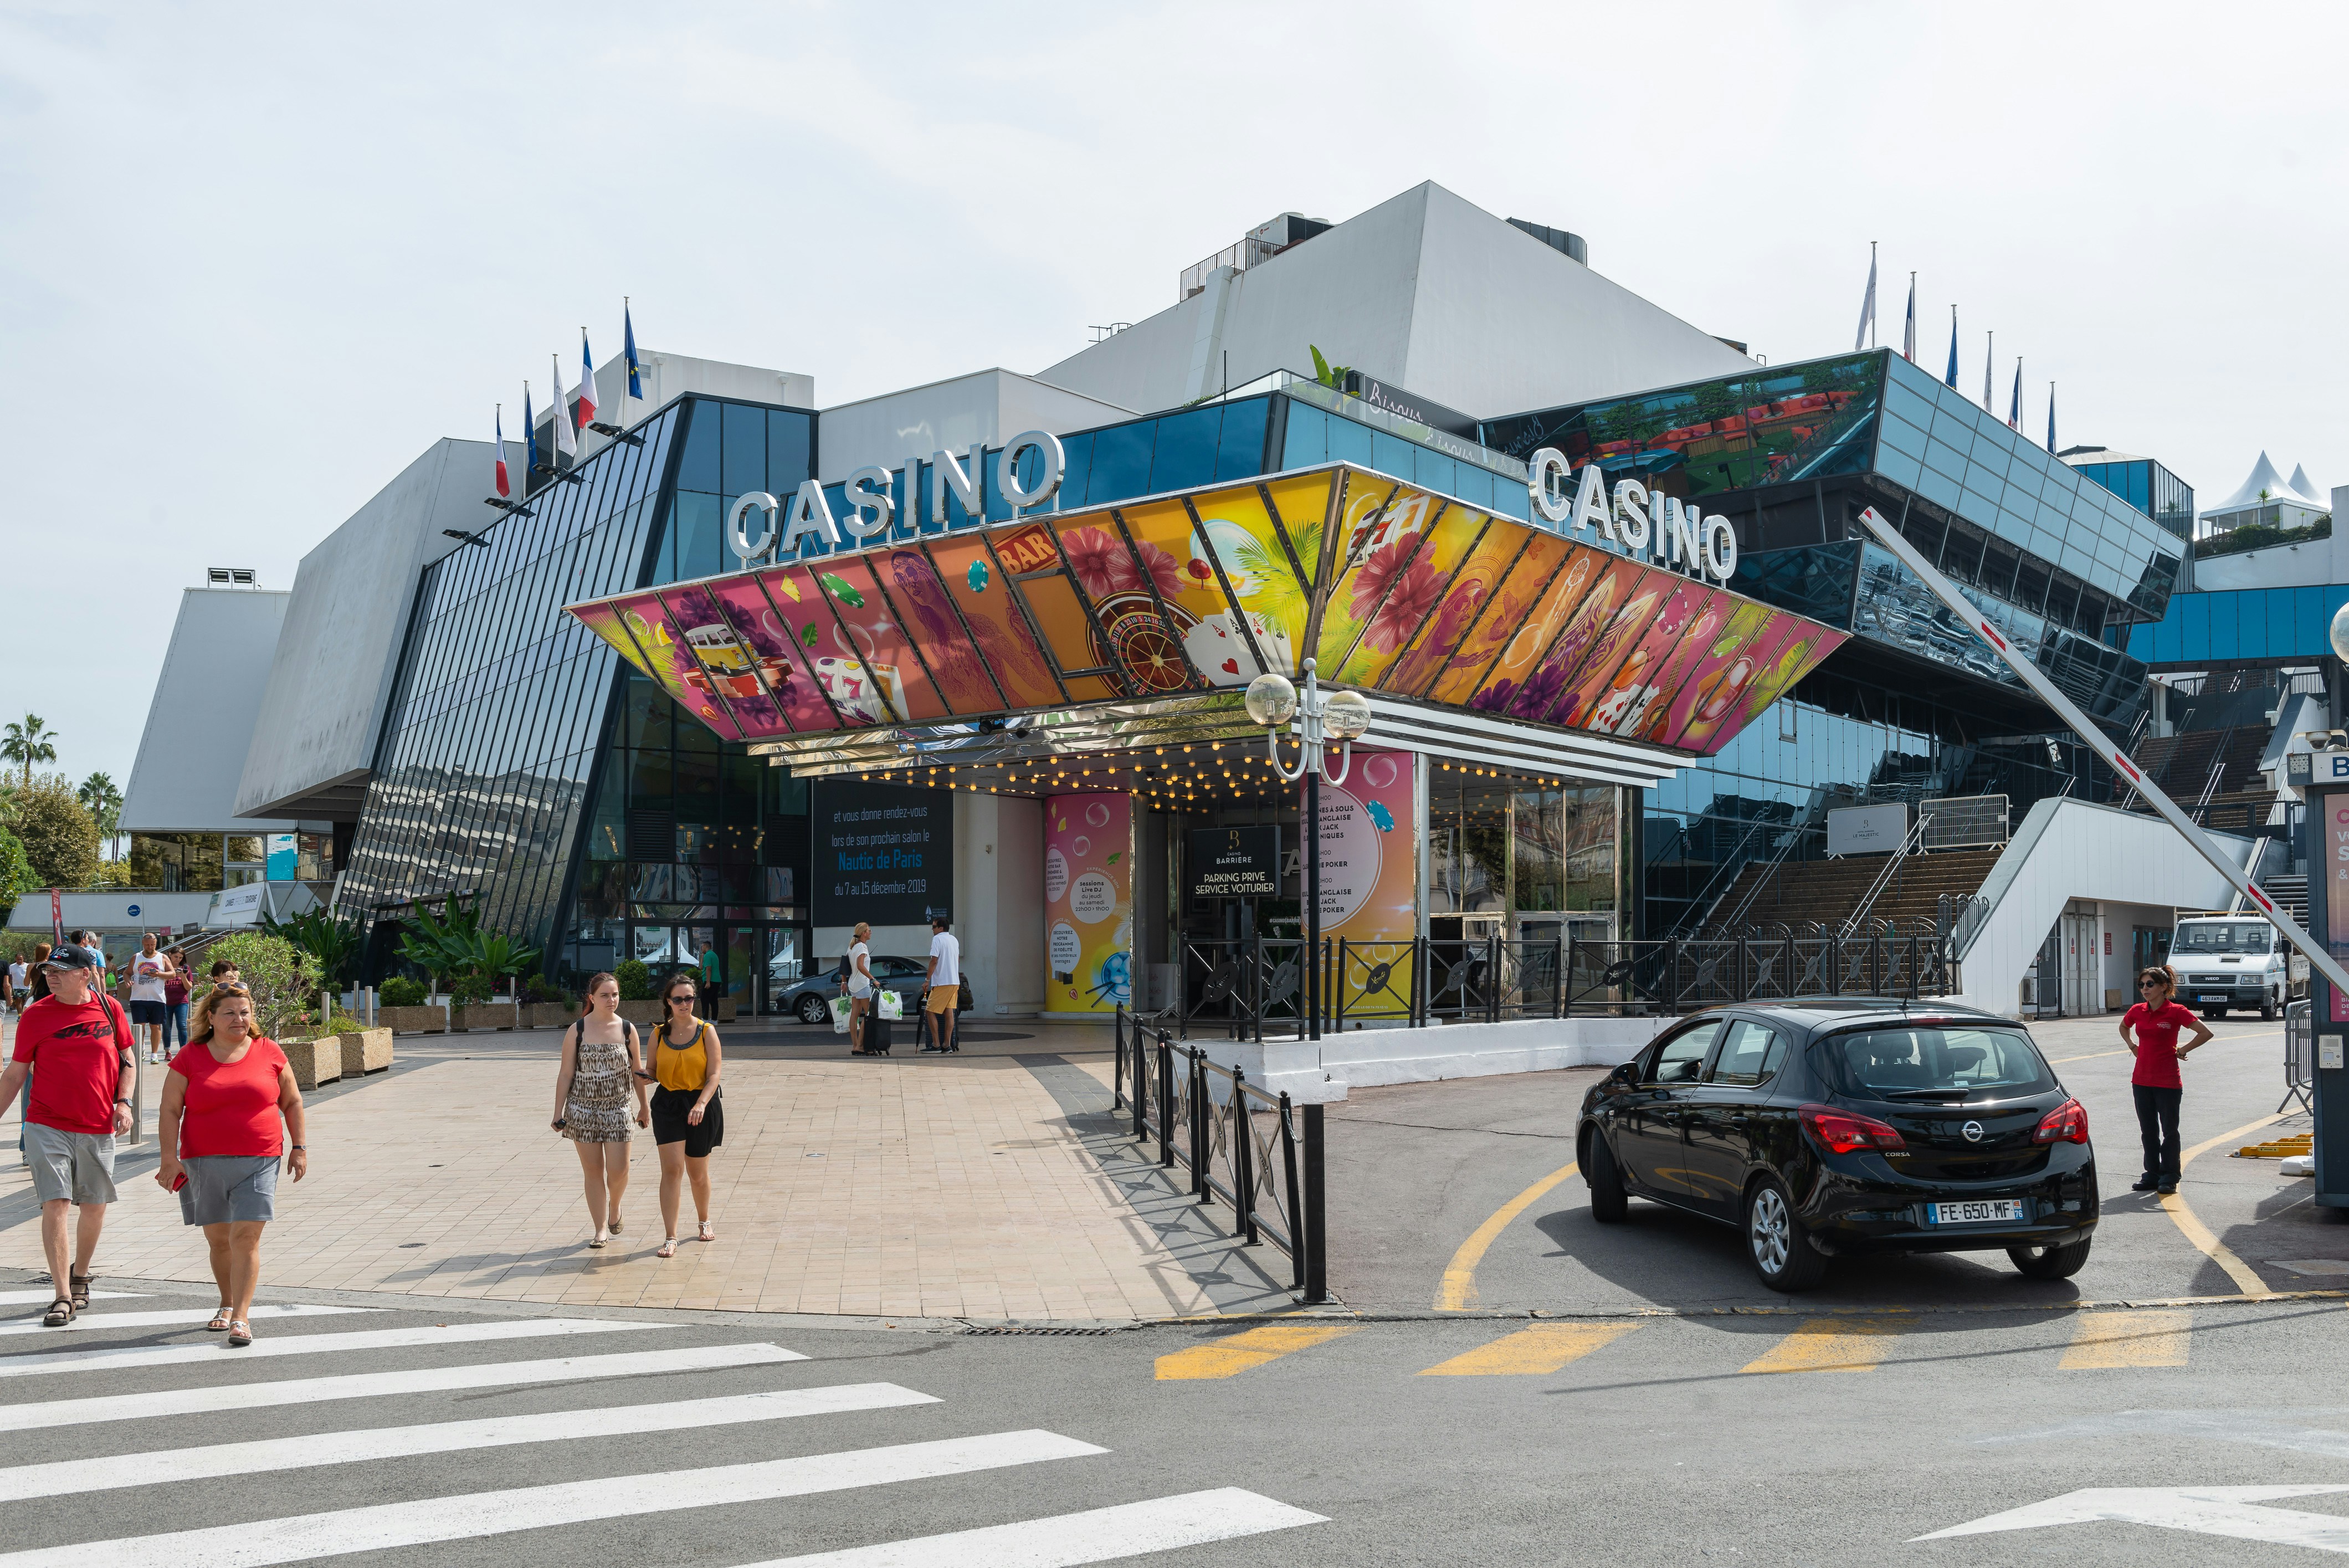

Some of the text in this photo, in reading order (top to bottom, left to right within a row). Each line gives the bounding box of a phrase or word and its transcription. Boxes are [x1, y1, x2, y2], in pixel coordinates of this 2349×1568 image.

[1369, 382, 1423, 425] Bisous
[727, 431, 1065, 559] CASINO
[1529, 447, 1737, 579] CASINO
[998, 532, 1055, 575] BAR
[834, 805, 927, 822] et vous donne rendez-vous
[1319, 814, 1351, 822] ANGLAISE
[832, 829, 930, 847] lors de son prochain salon le
[2336, 831, 2349, 842] V
[839, 848, 922, 871] Nautic de Paris
[1112, 879, 1121, 889] SON
[1204, 872, 1265, 883] PARKING PRIVE
[835, 879, 926, 895] du 7 au 15 décembre 2019
[1196, 883, 1274, 894] SERVICE VOITURIER
[50, 947, 69, 957] Nice
[1940, 1202, 2010, 1221] FE-650-MF
